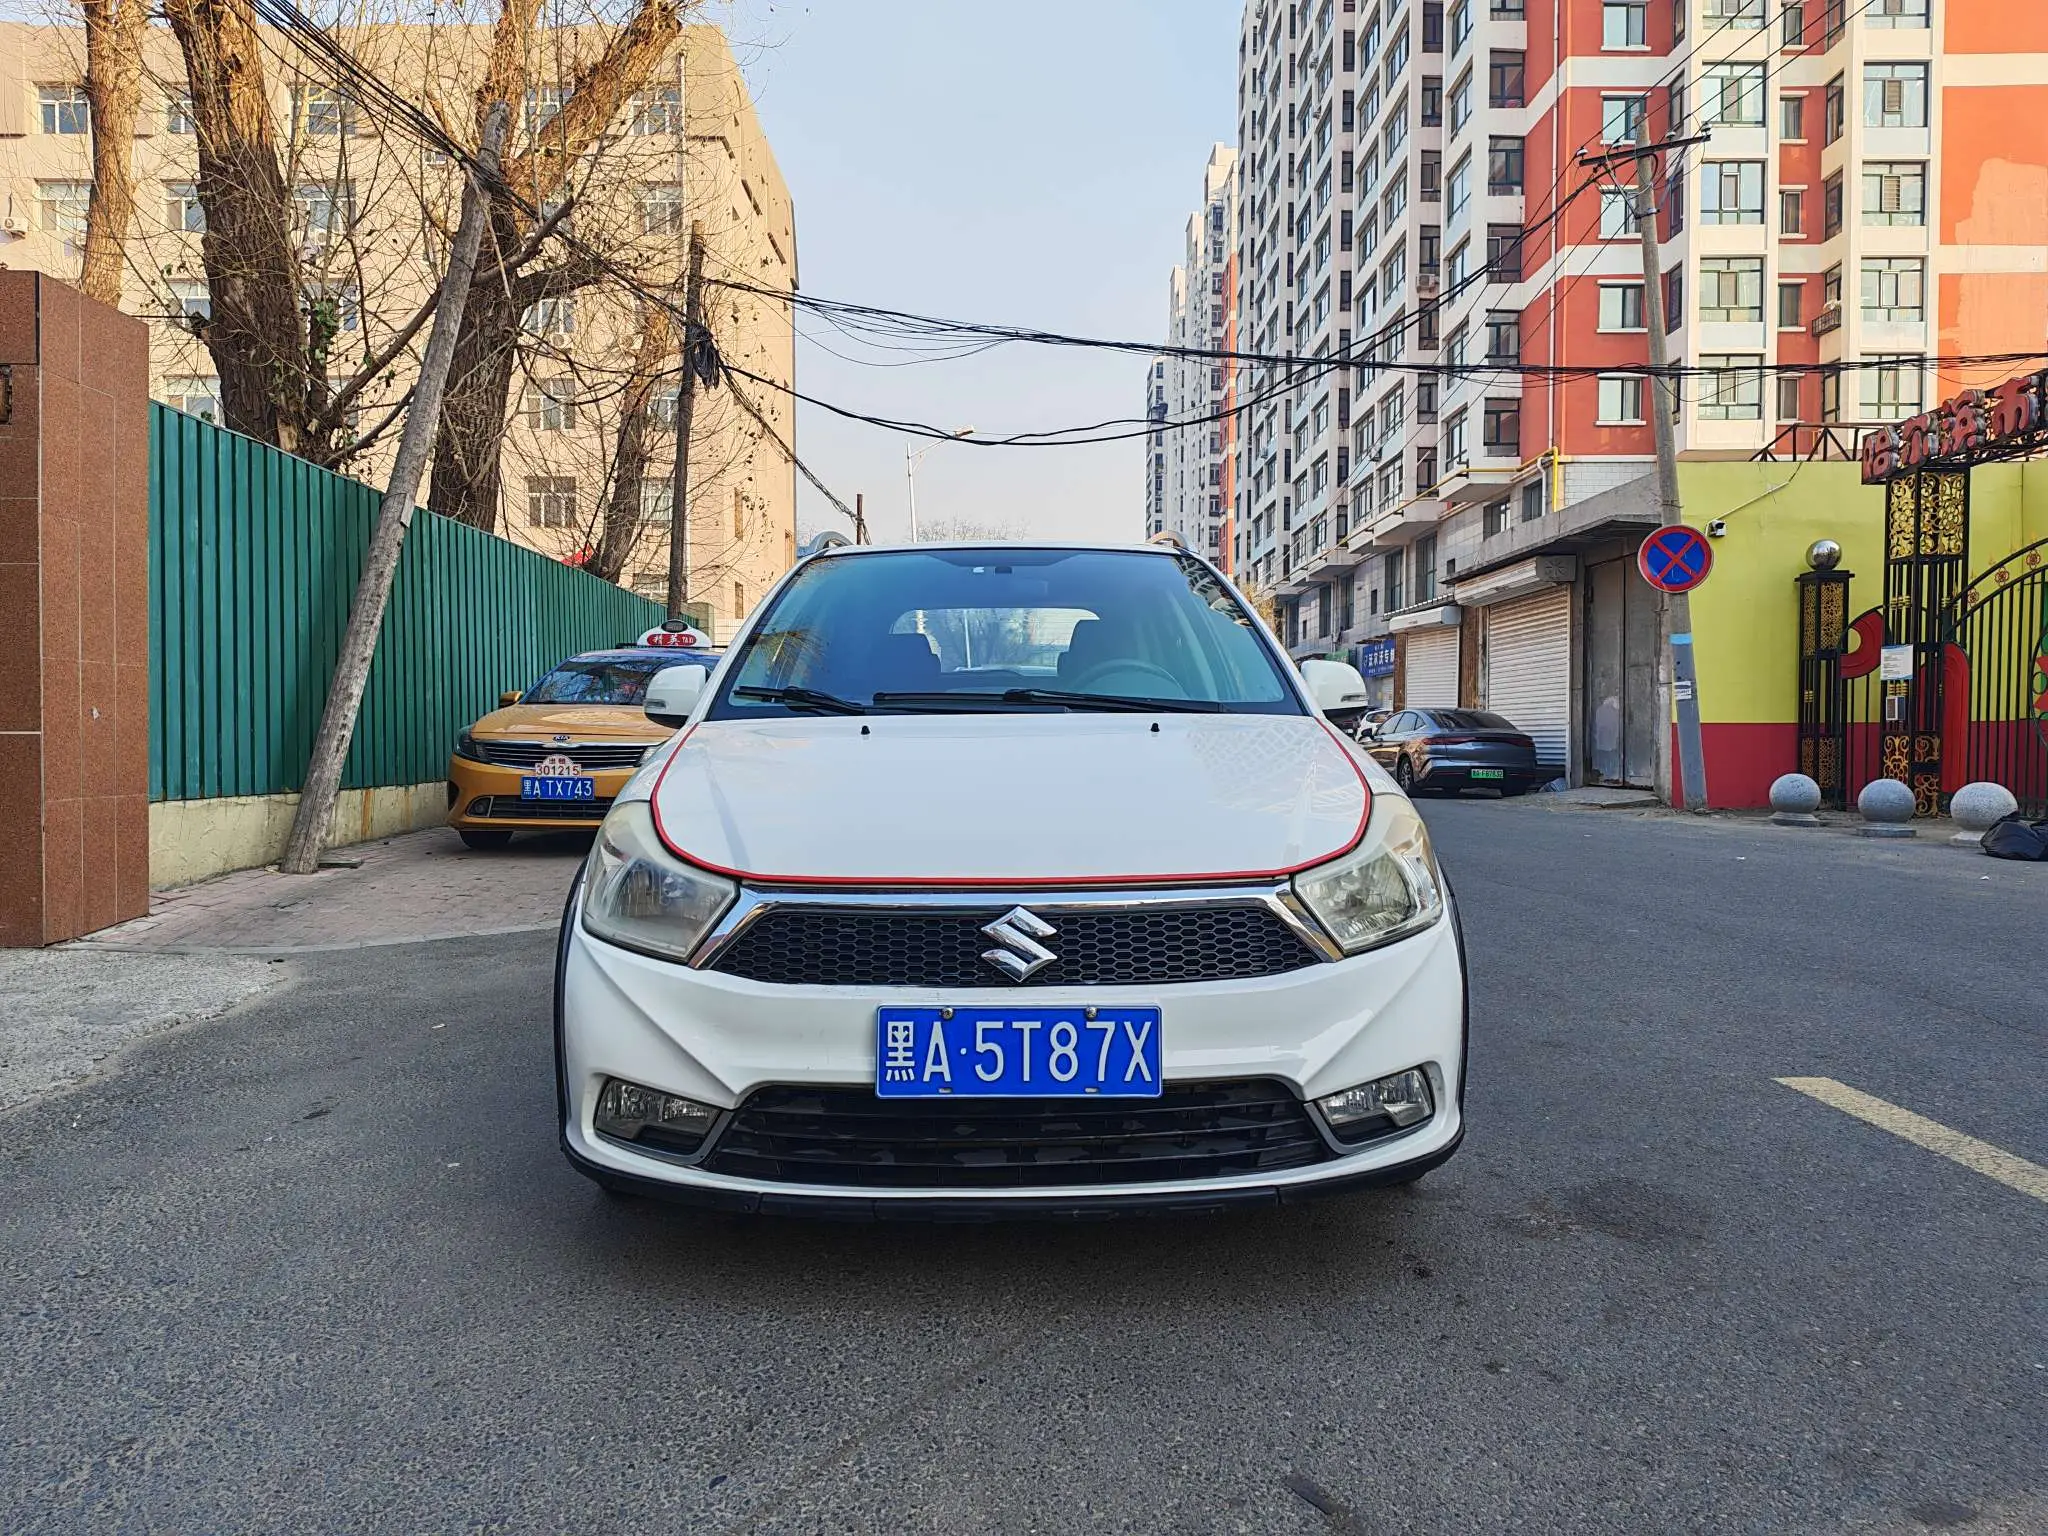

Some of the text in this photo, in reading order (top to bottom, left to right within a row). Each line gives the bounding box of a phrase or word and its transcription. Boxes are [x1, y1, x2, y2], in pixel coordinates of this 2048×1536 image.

[682, 636, 694, 644] TAXI
[536, 765, 580, 775] 301215
[885, 1020, 1154, 1083] 黑A·5T87X
